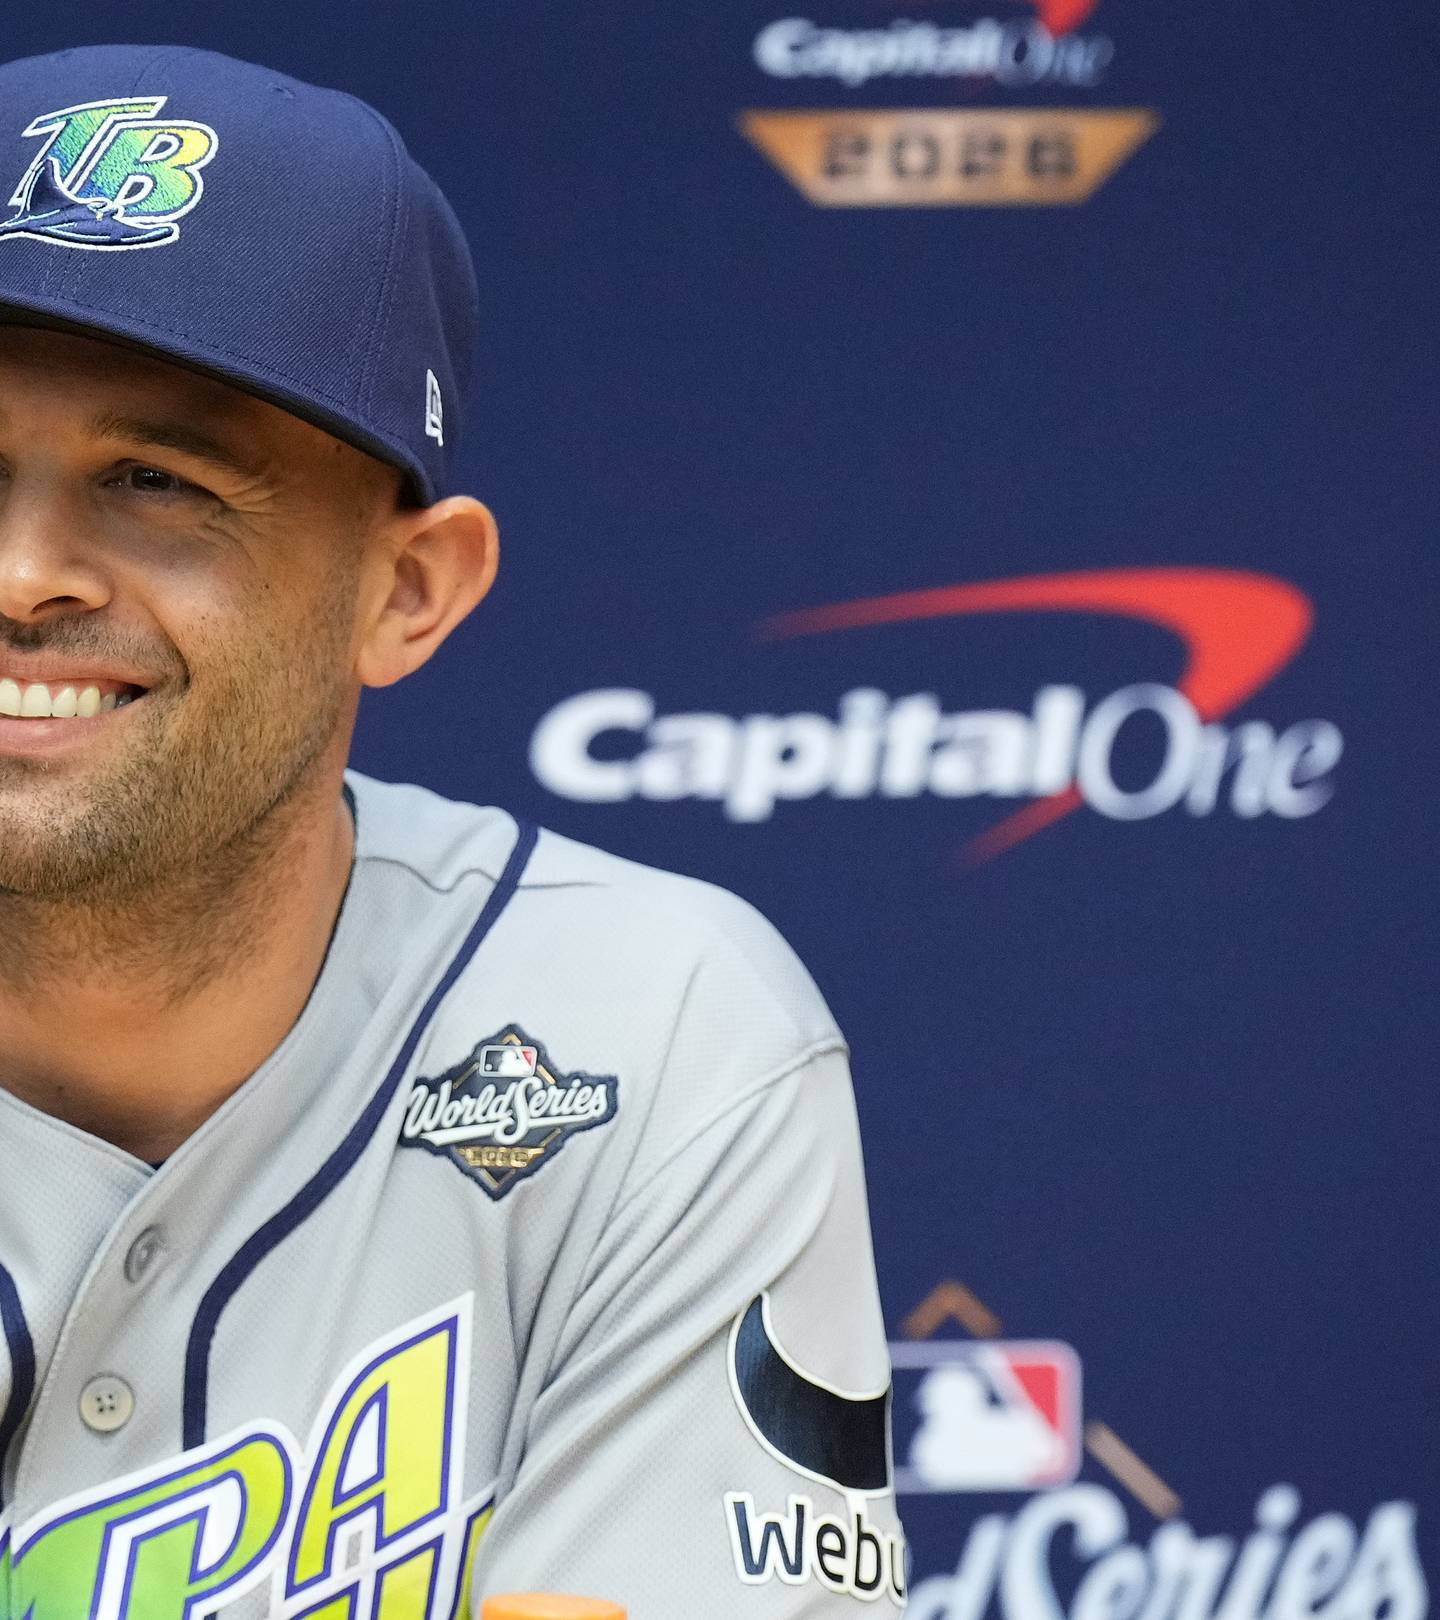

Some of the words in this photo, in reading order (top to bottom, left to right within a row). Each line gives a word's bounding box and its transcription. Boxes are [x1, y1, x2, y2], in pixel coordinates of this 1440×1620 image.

[9, 96, 220, 226] TB
[530, 684, 1084, 822] Capital
[1078, 682, 1344, 820] One
[404, 1080, 517, 1138] World
[493, 1076, 608, 1145] Series
